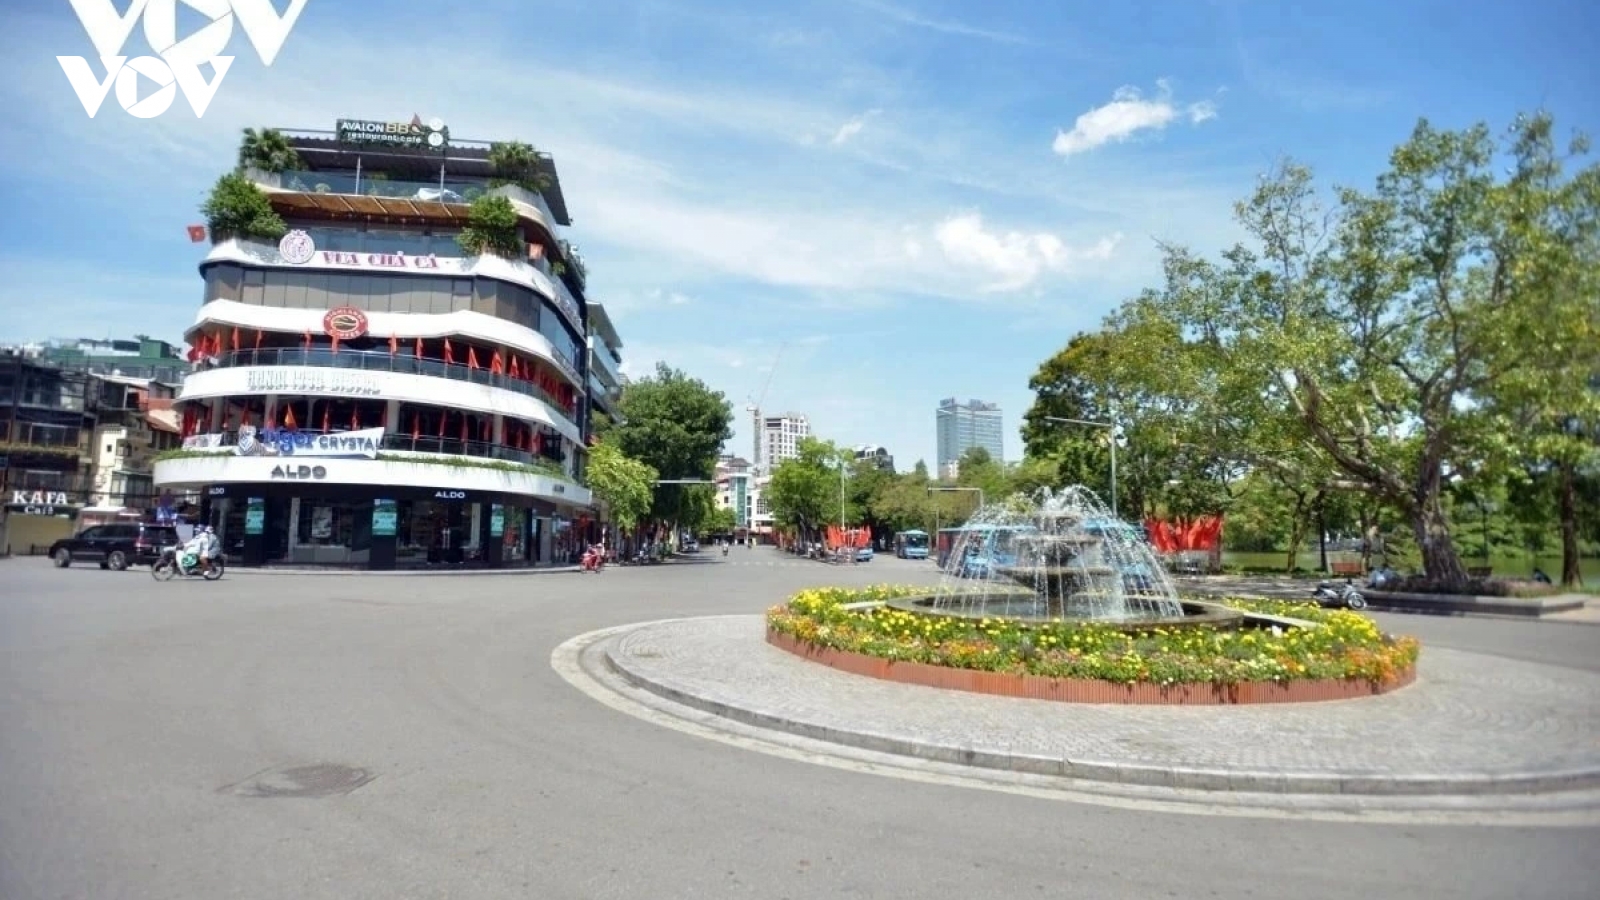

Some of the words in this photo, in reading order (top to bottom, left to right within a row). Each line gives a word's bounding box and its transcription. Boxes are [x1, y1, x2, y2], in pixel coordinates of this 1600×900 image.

[341, 122, 385, 133] AVALON
[323, 251, 361, 265] VUA
[270, 464, 327, 479] ALDO
[434, 490, 466, 499] ALDO
